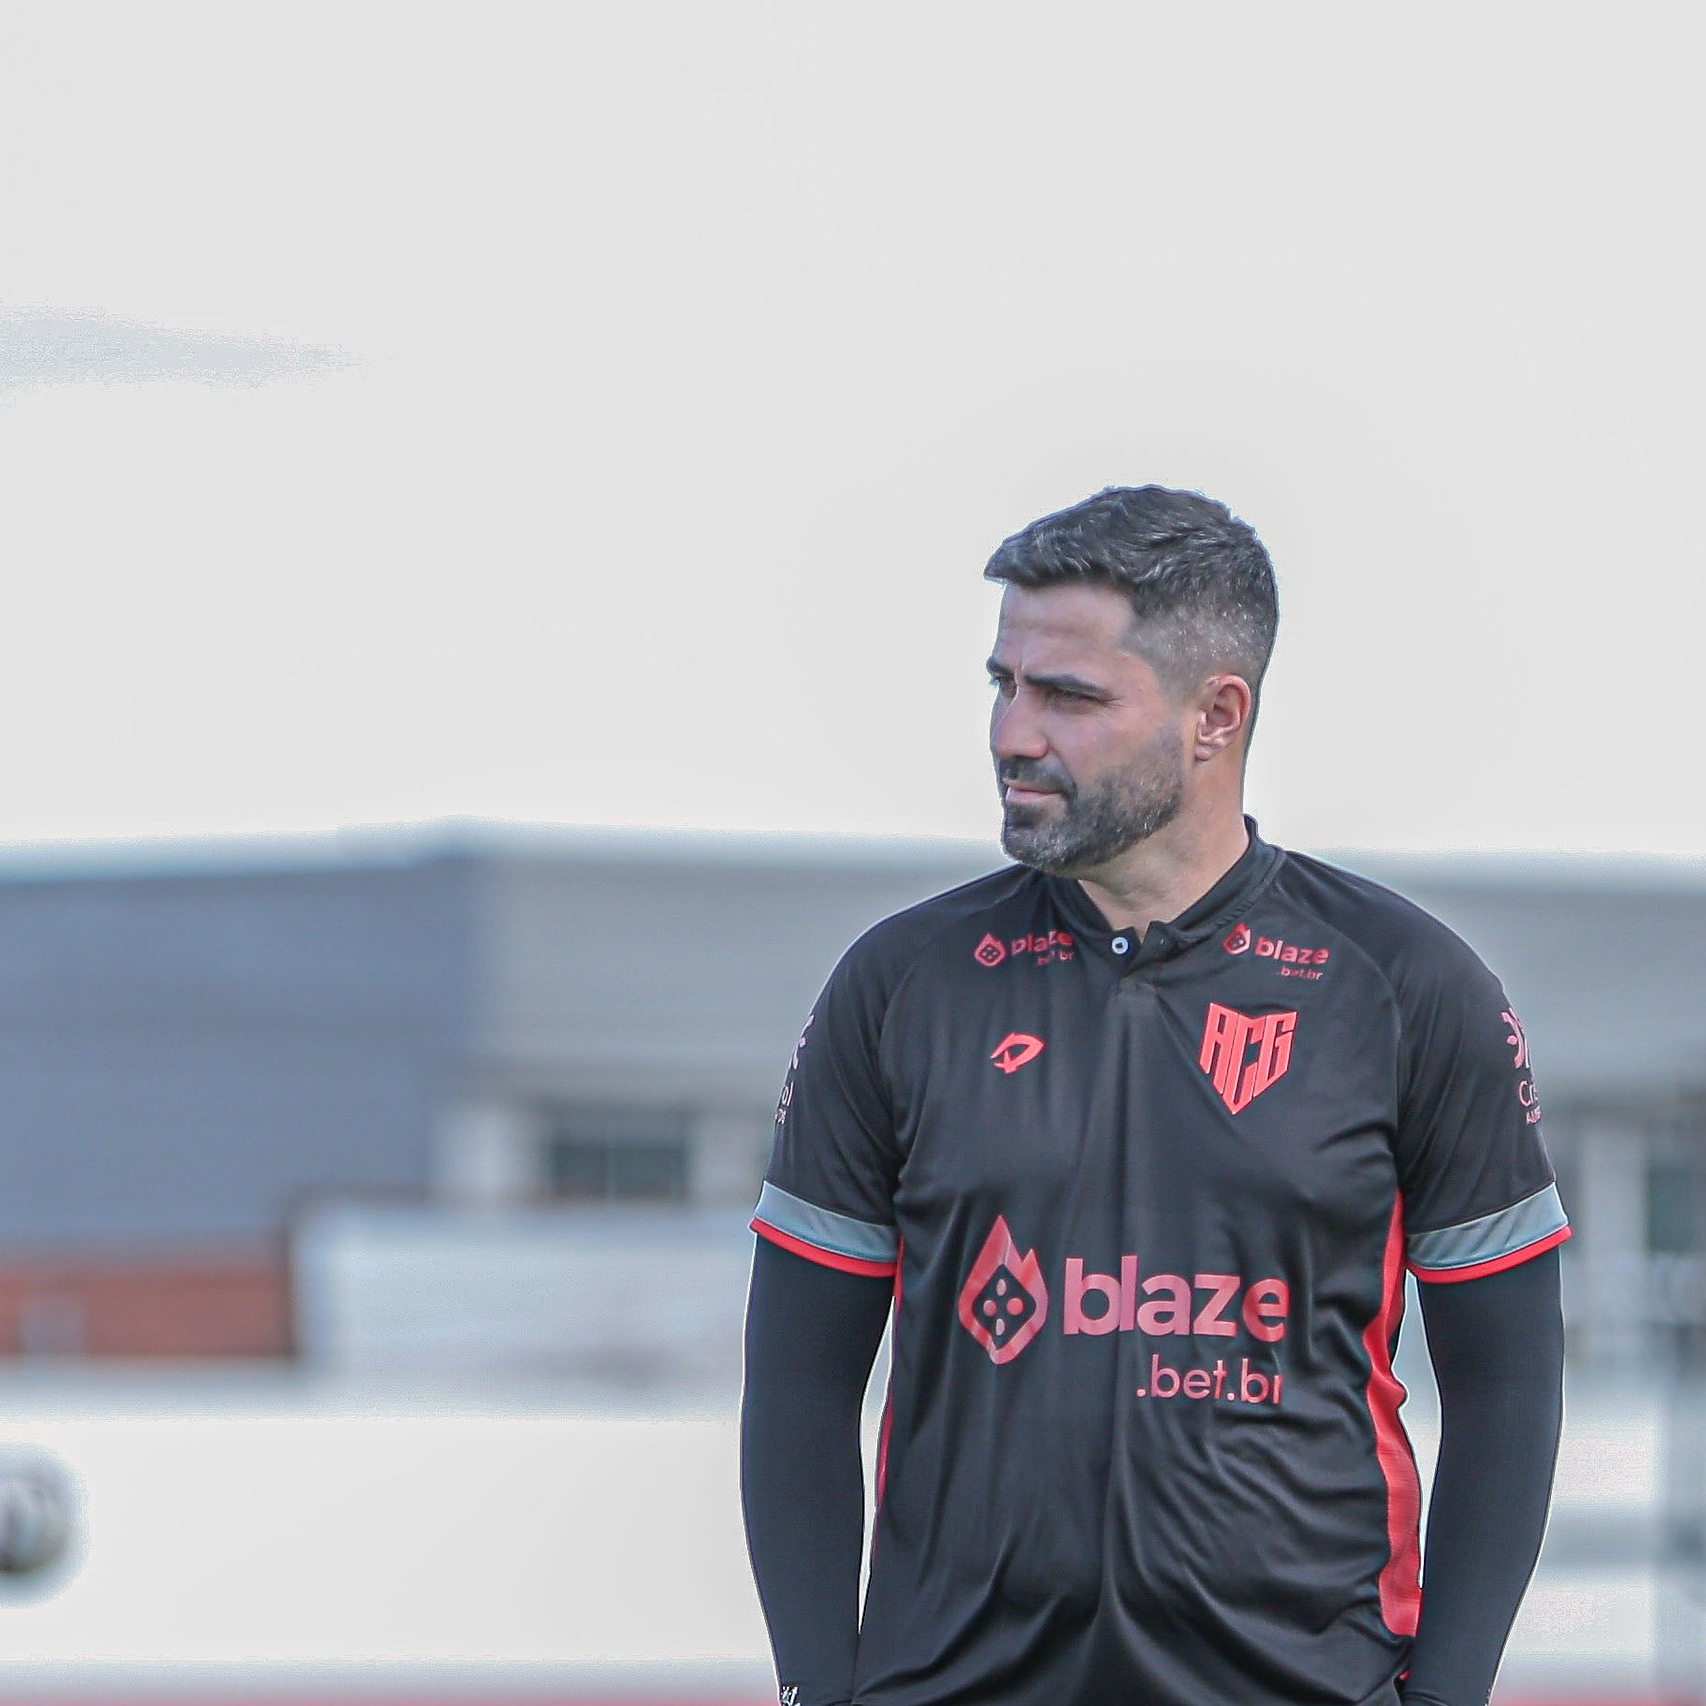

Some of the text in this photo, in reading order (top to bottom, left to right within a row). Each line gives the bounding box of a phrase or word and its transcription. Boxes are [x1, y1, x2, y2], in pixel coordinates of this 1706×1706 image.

[1255, 937, 1330, 964] blaze
[1199, 1002, 1297, 1115] ACG
[1063, 1255, 1291, 1343] blaze
